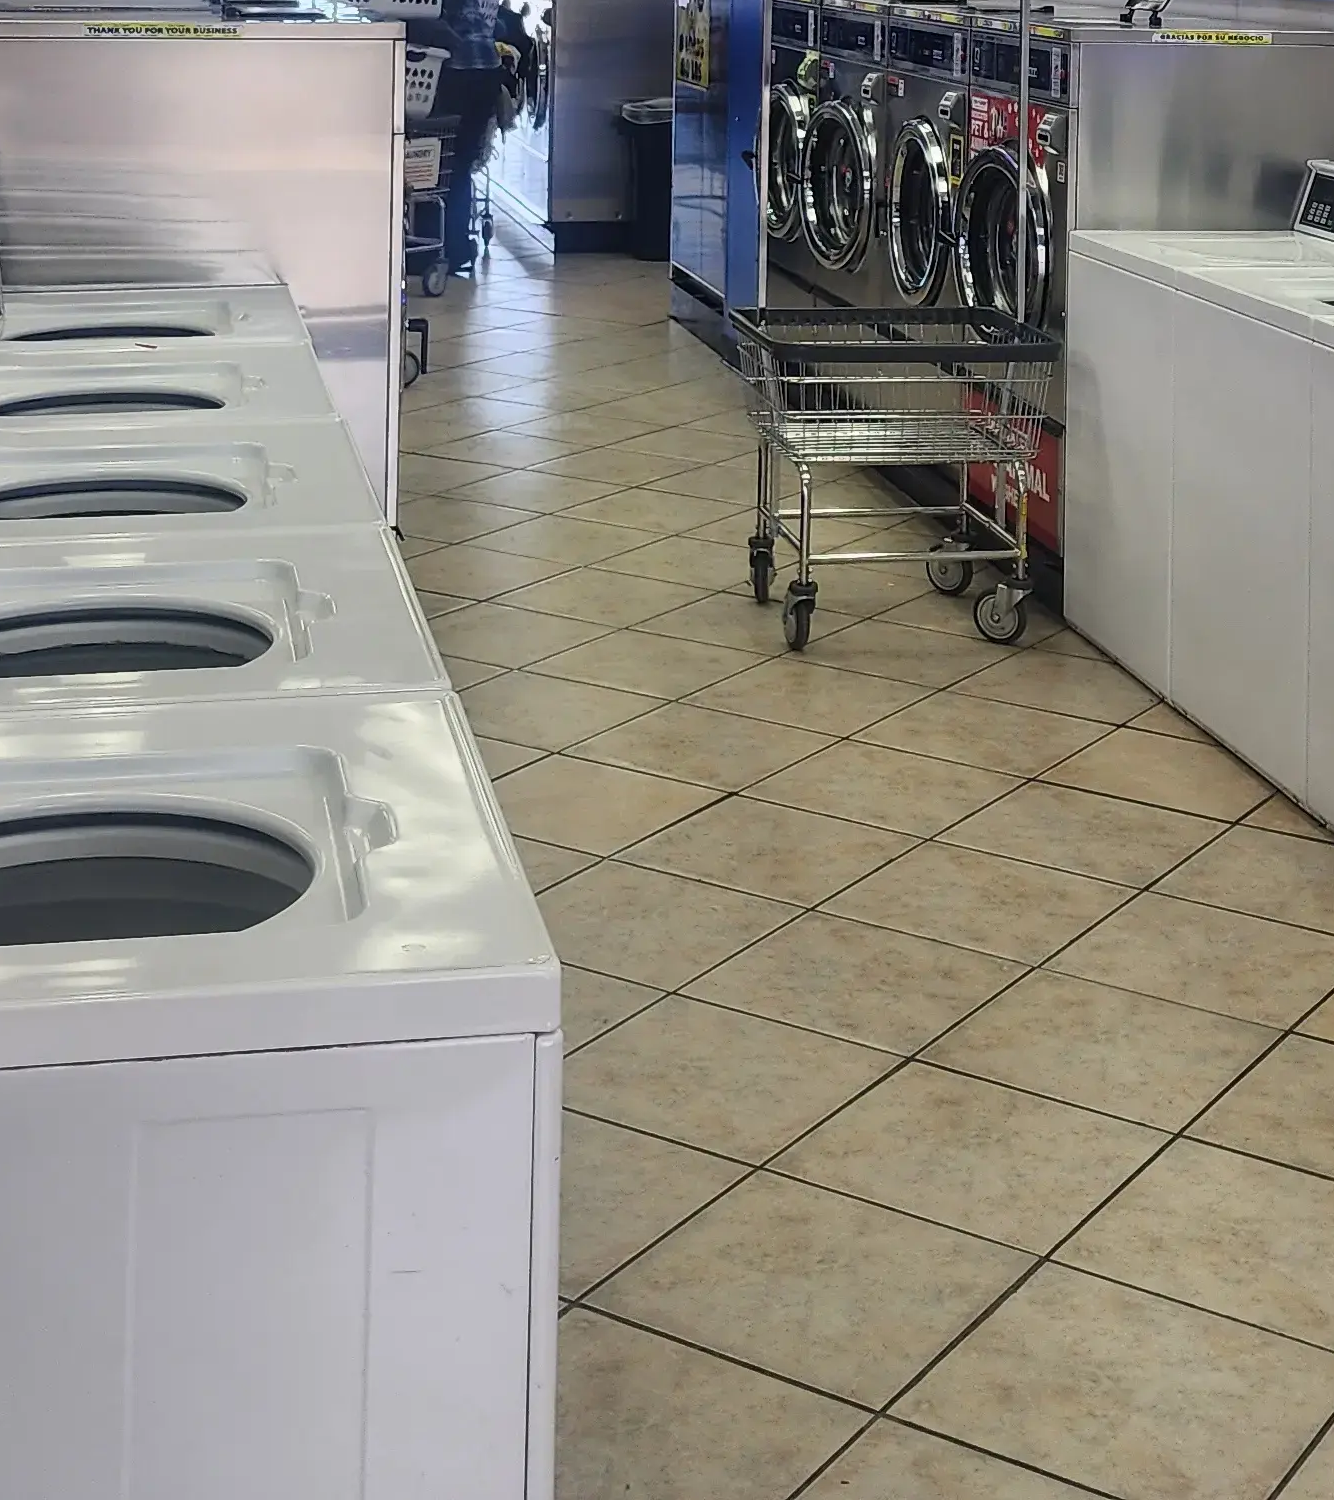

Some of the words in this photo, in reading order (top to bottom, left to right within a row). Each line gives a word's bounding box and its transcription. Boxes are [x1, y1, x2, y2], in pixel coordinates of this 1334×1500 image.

[87, 26, 120, 35] THANK
[122, 26, 143, 35] YOU
[144, 26, 164, 35] FOR
[165, 26, 192, 35] YOUR
[193, 26, 238, 35] BUSINESS
[1159, 33, 1195, 41] GRACIAS
[1227, 34, 1264, 42] NEGOCIO
